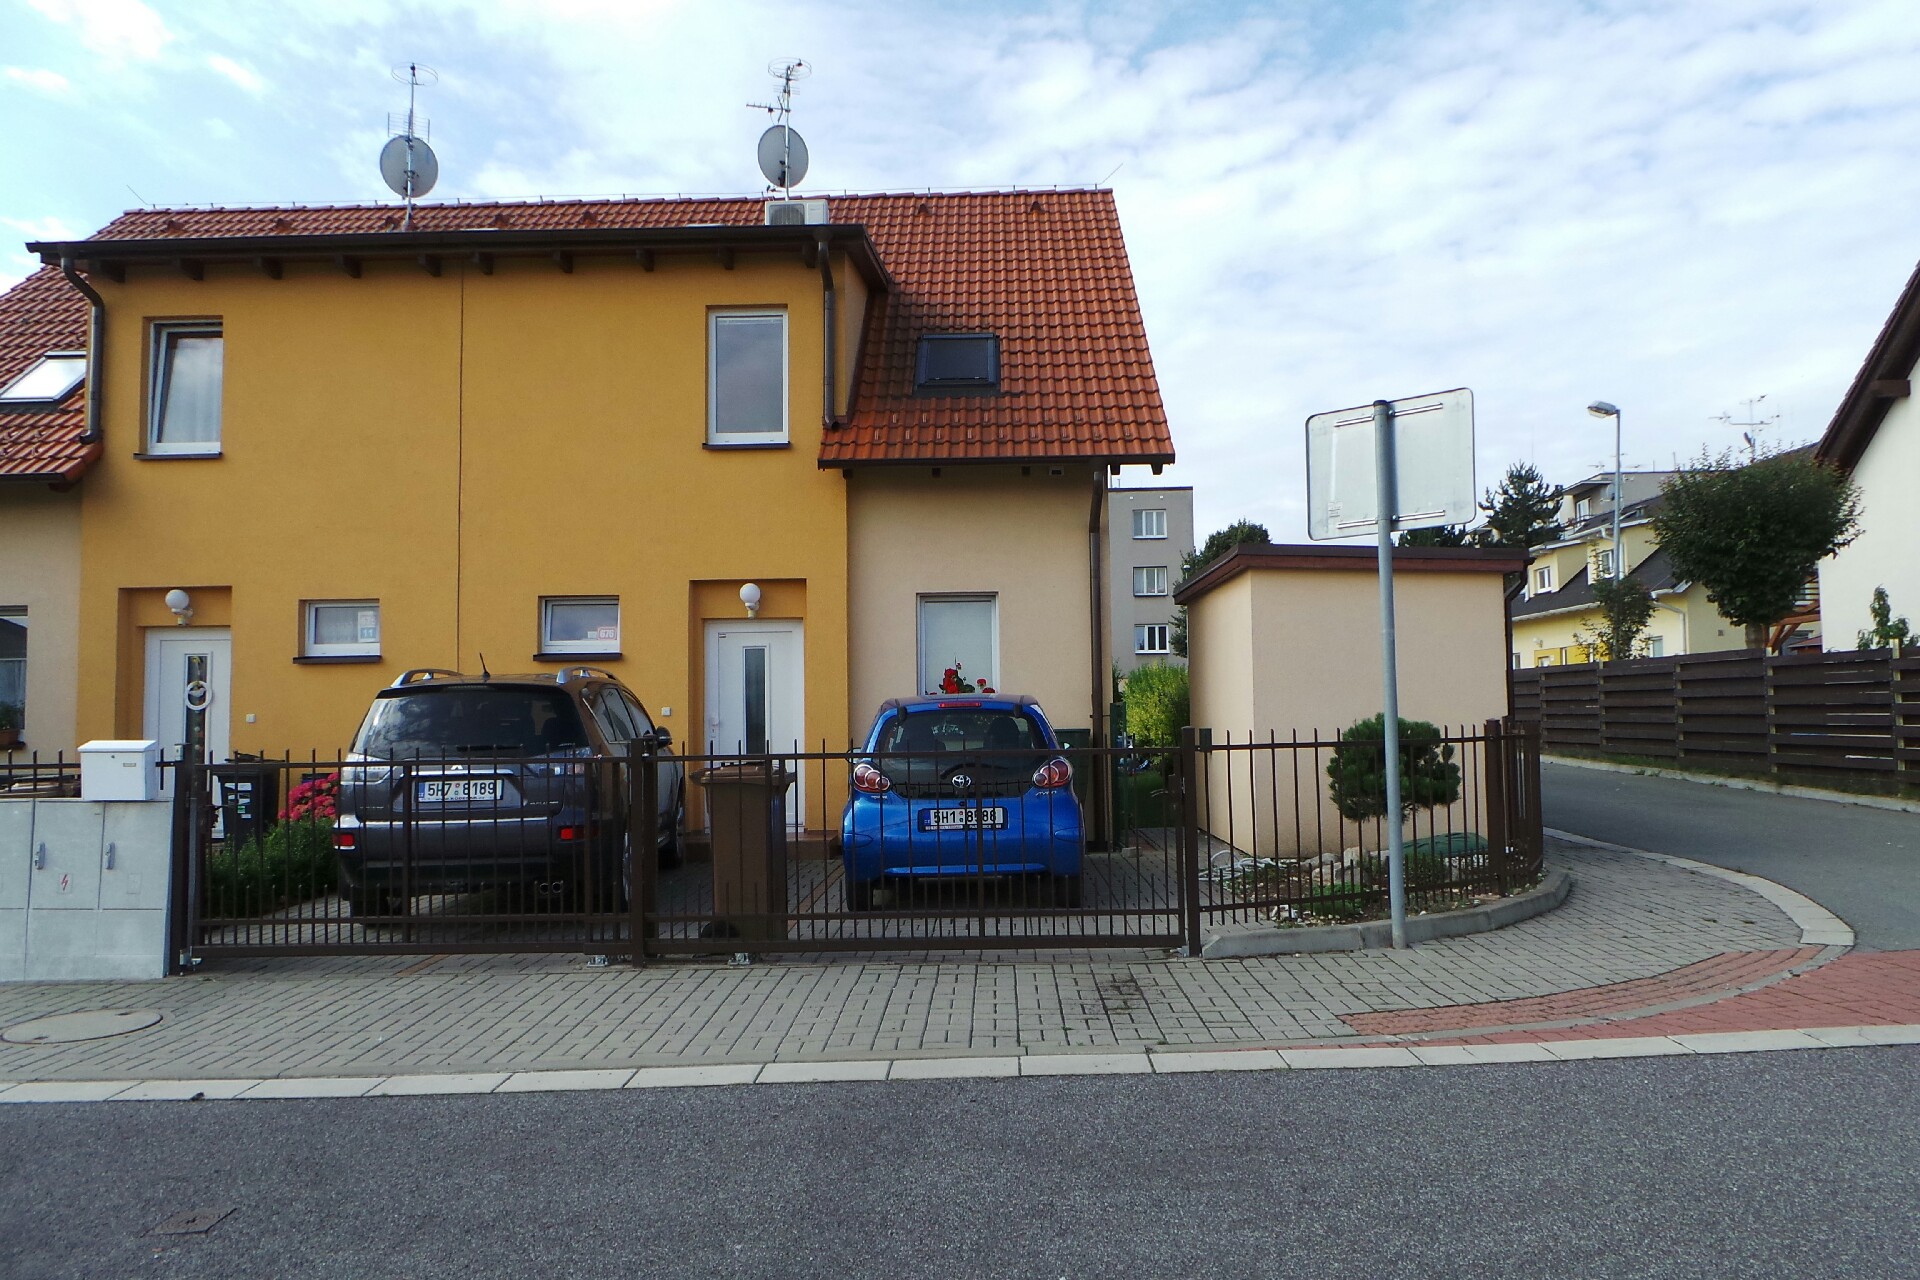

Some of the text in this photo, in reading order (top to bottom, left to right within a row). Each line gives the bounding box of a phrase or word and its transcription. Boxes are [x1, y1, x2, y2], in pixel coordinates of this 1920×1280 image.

[427, 782, 495, 796] 5H7 8189
[933, 811, 956, 823] 5H1
